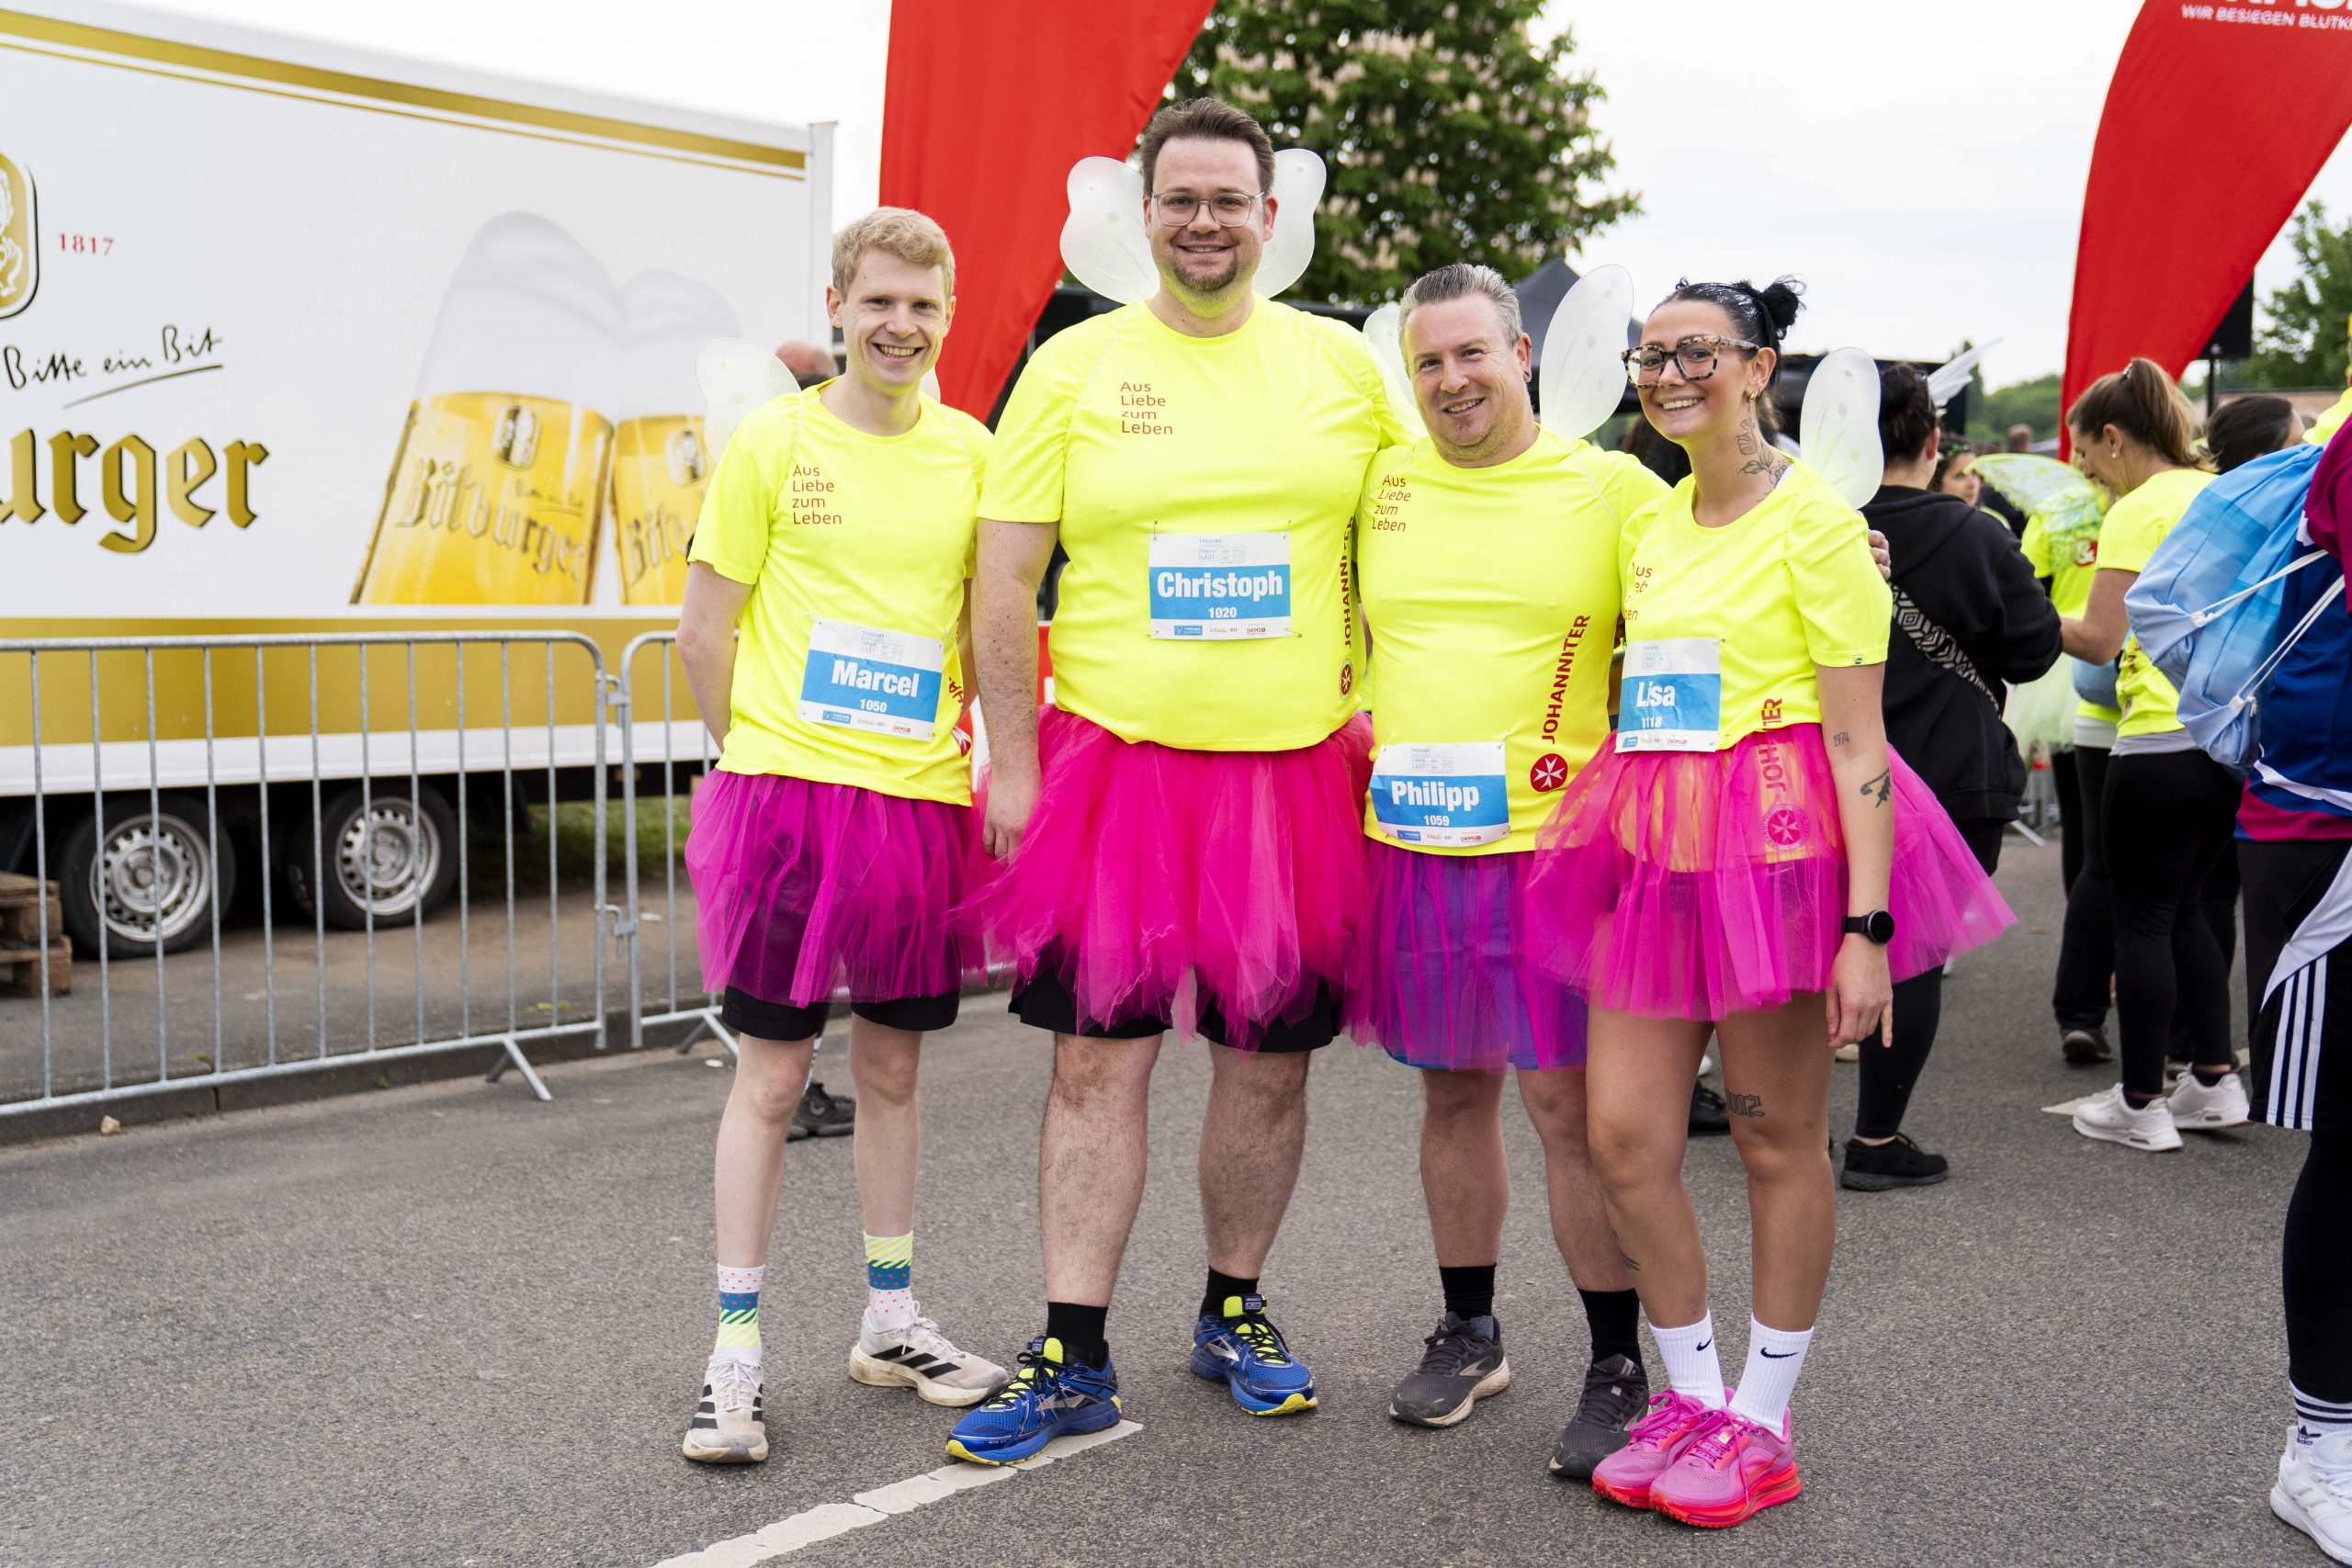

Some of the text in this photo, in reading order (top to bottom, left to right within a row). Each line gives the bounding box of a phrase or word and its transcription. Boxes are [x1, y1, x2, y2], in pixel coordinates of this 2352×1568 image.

[2181, 4, 2213, 19] WIR
[2216, 6, 2296, 27] BESIEGEN
[2299, 13, 2352, 30] BLUTK
[58, 232, 115, 255] 1817
[4, 324, 222, 389] Bitte ein Bit
[1120, 381, 1151, 392] Aus
[1121, 394, 1166, 407] Liebe
[1121, 411, 1157, 420] zum
[1122, 420, 1173, 434] Leben
[793, 465, 820, 477] Aus
[793, 479, 835, 492] Liebe
[1382, 474, 1407, 488] Aus
[1378, 488, 1412, 502] Liebe
[792, 498, 826, 508] zum
[1374, 505, 1398, 515] zum
[793, 511, 842, 525] Leben
[1372, 517, 1407, 532] Leben
[1157, 570, 1283, 602] Christoph
[1208, 607, 1238, 618] 1020
[831, 659, 920, 698] Marcel
[1542, 615, 1590, 745] JOHANNITER
[1636, 681, 1676, 707] Lisa
[859, 698, 888, 714] 1050
[1641, 716, 1663, 728] 1118
[1391, 781, 1480, 812] Philipp
[1424, 815, 1450, 826] 1059
